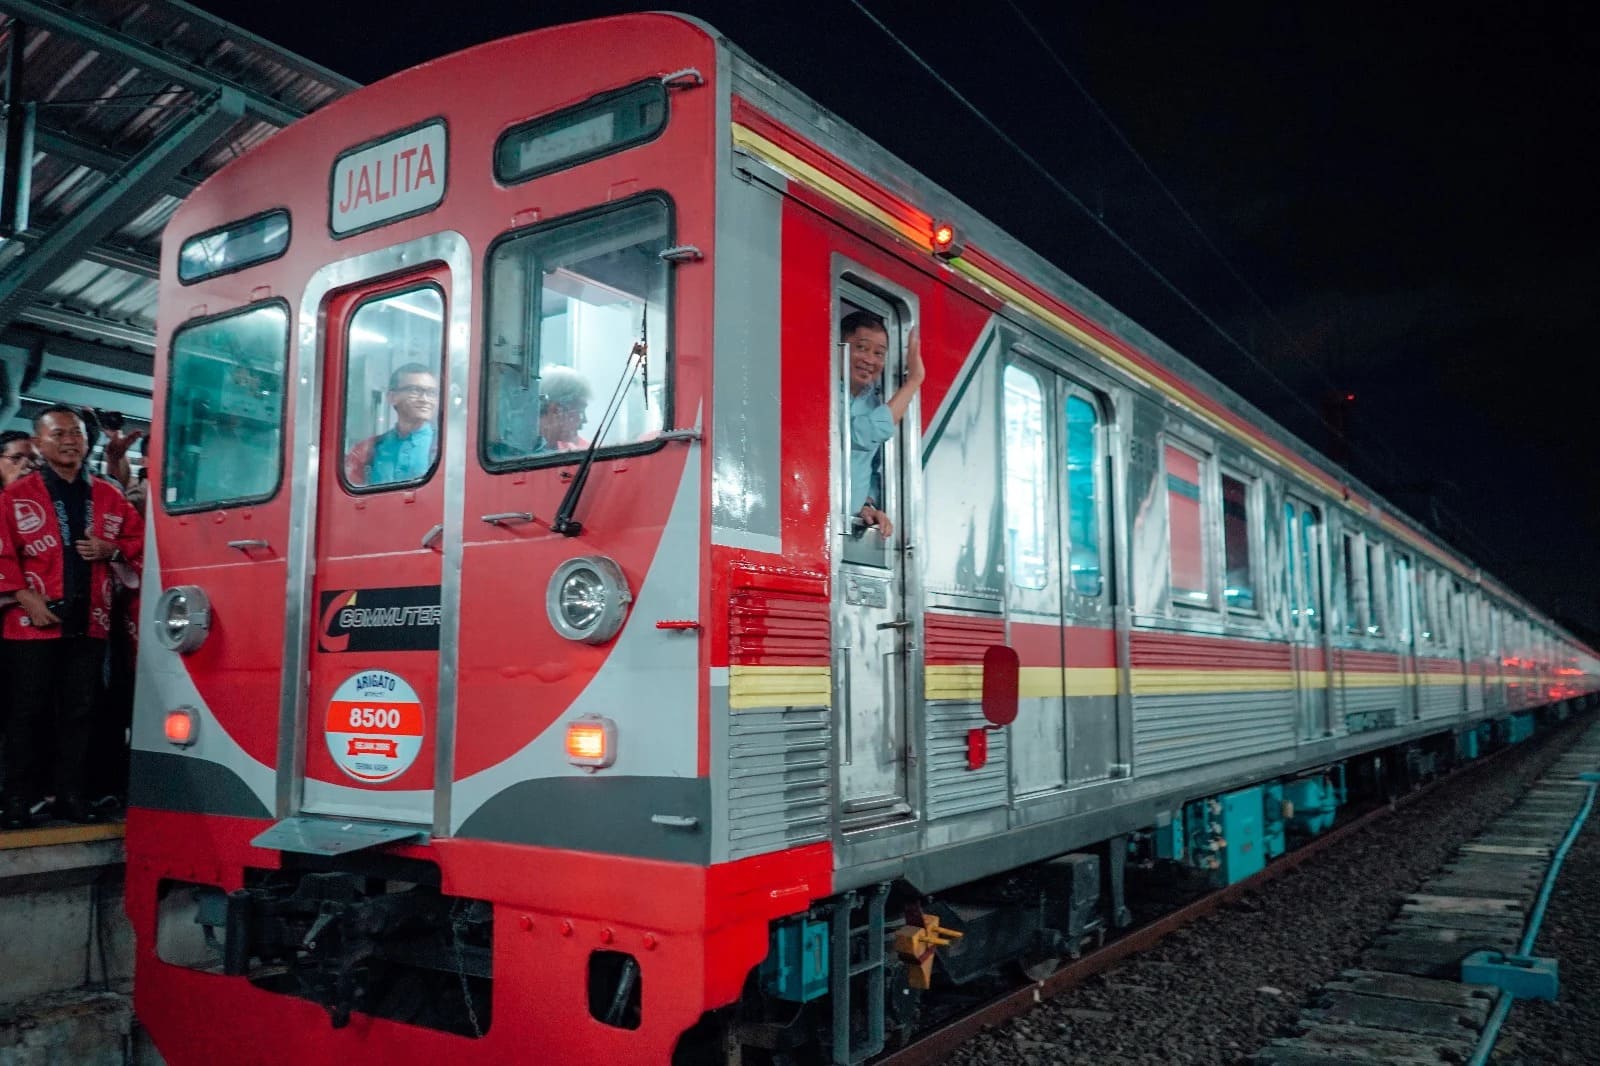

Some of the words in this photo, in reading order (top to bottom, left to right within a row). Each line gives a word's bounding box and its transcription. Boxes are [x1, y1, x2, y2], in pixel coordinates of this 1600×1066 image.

[338, 143, 436, 214] JALITA
[340, 605, 442, 628] COMMUTER
[356, 673, 396, 693] ARIGATO
[349, 707, 401, 729] 8500
